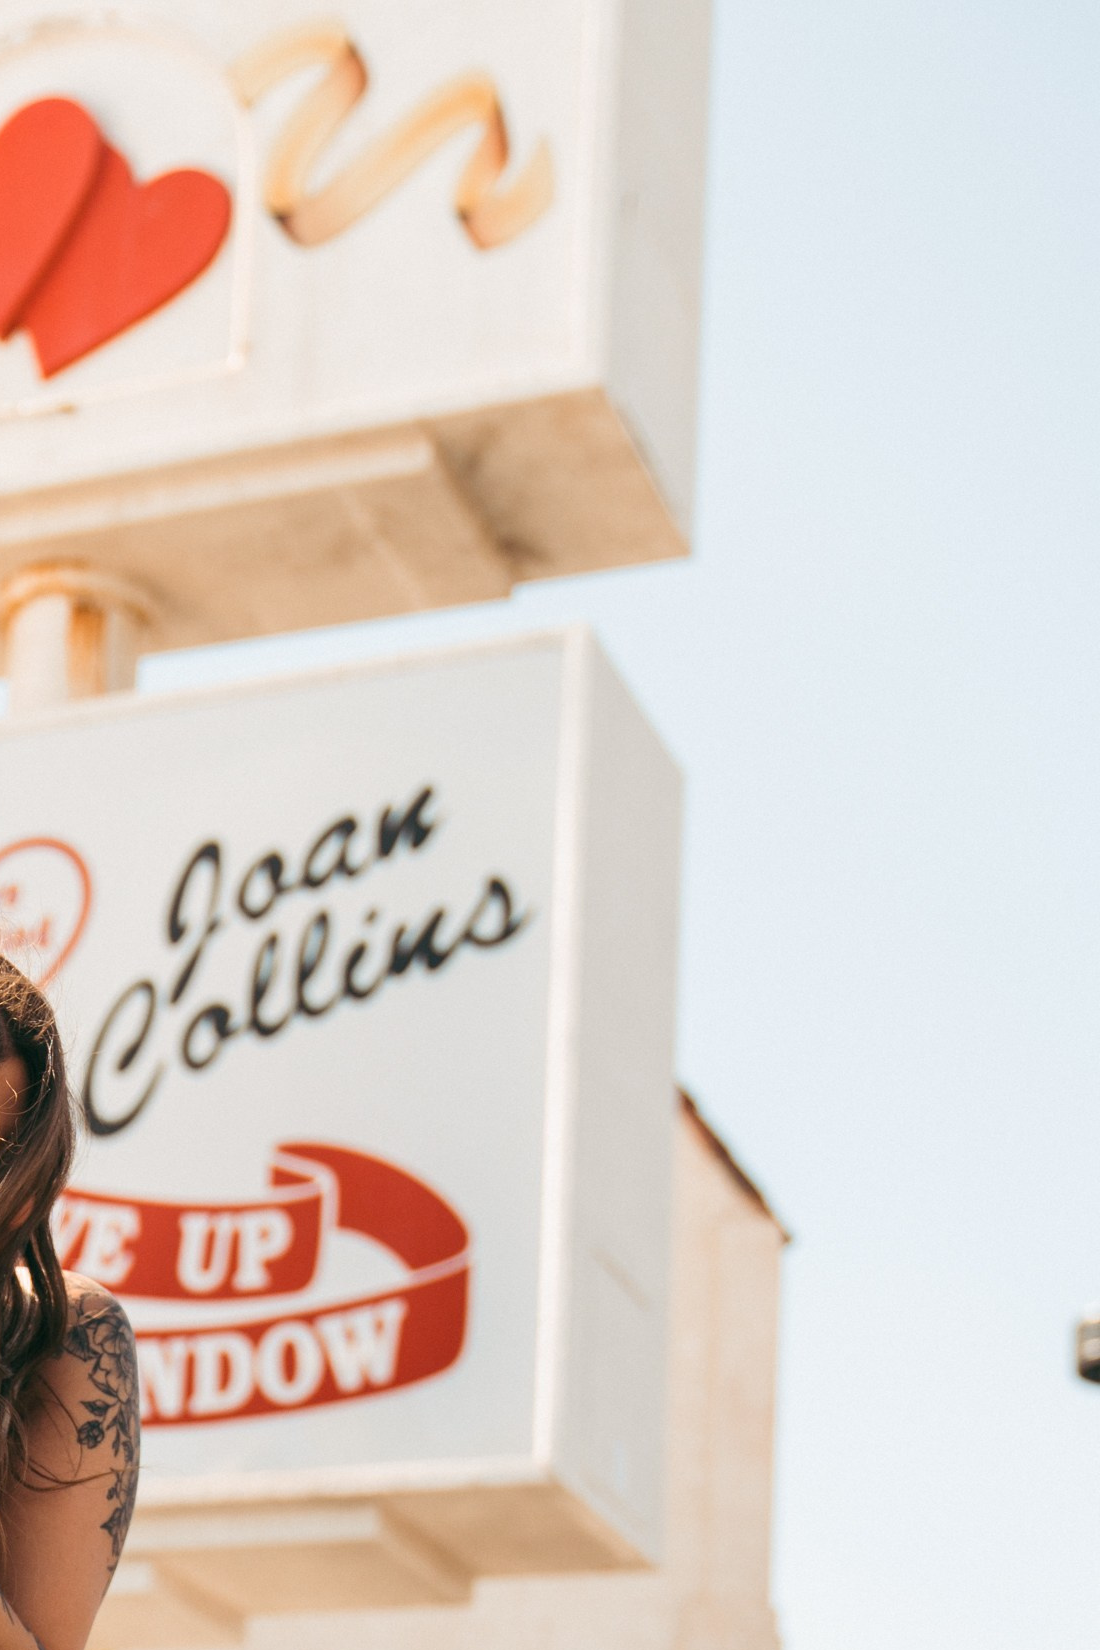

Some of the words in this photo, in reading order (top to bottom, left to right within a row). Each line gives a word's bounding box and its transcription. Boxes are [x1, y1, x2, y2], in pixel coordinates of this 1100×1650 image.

[167, 786, 438, 1003] Joan
[76, 875, 532, 1138] Collins
[176, 1207, 294, 1294] UP
